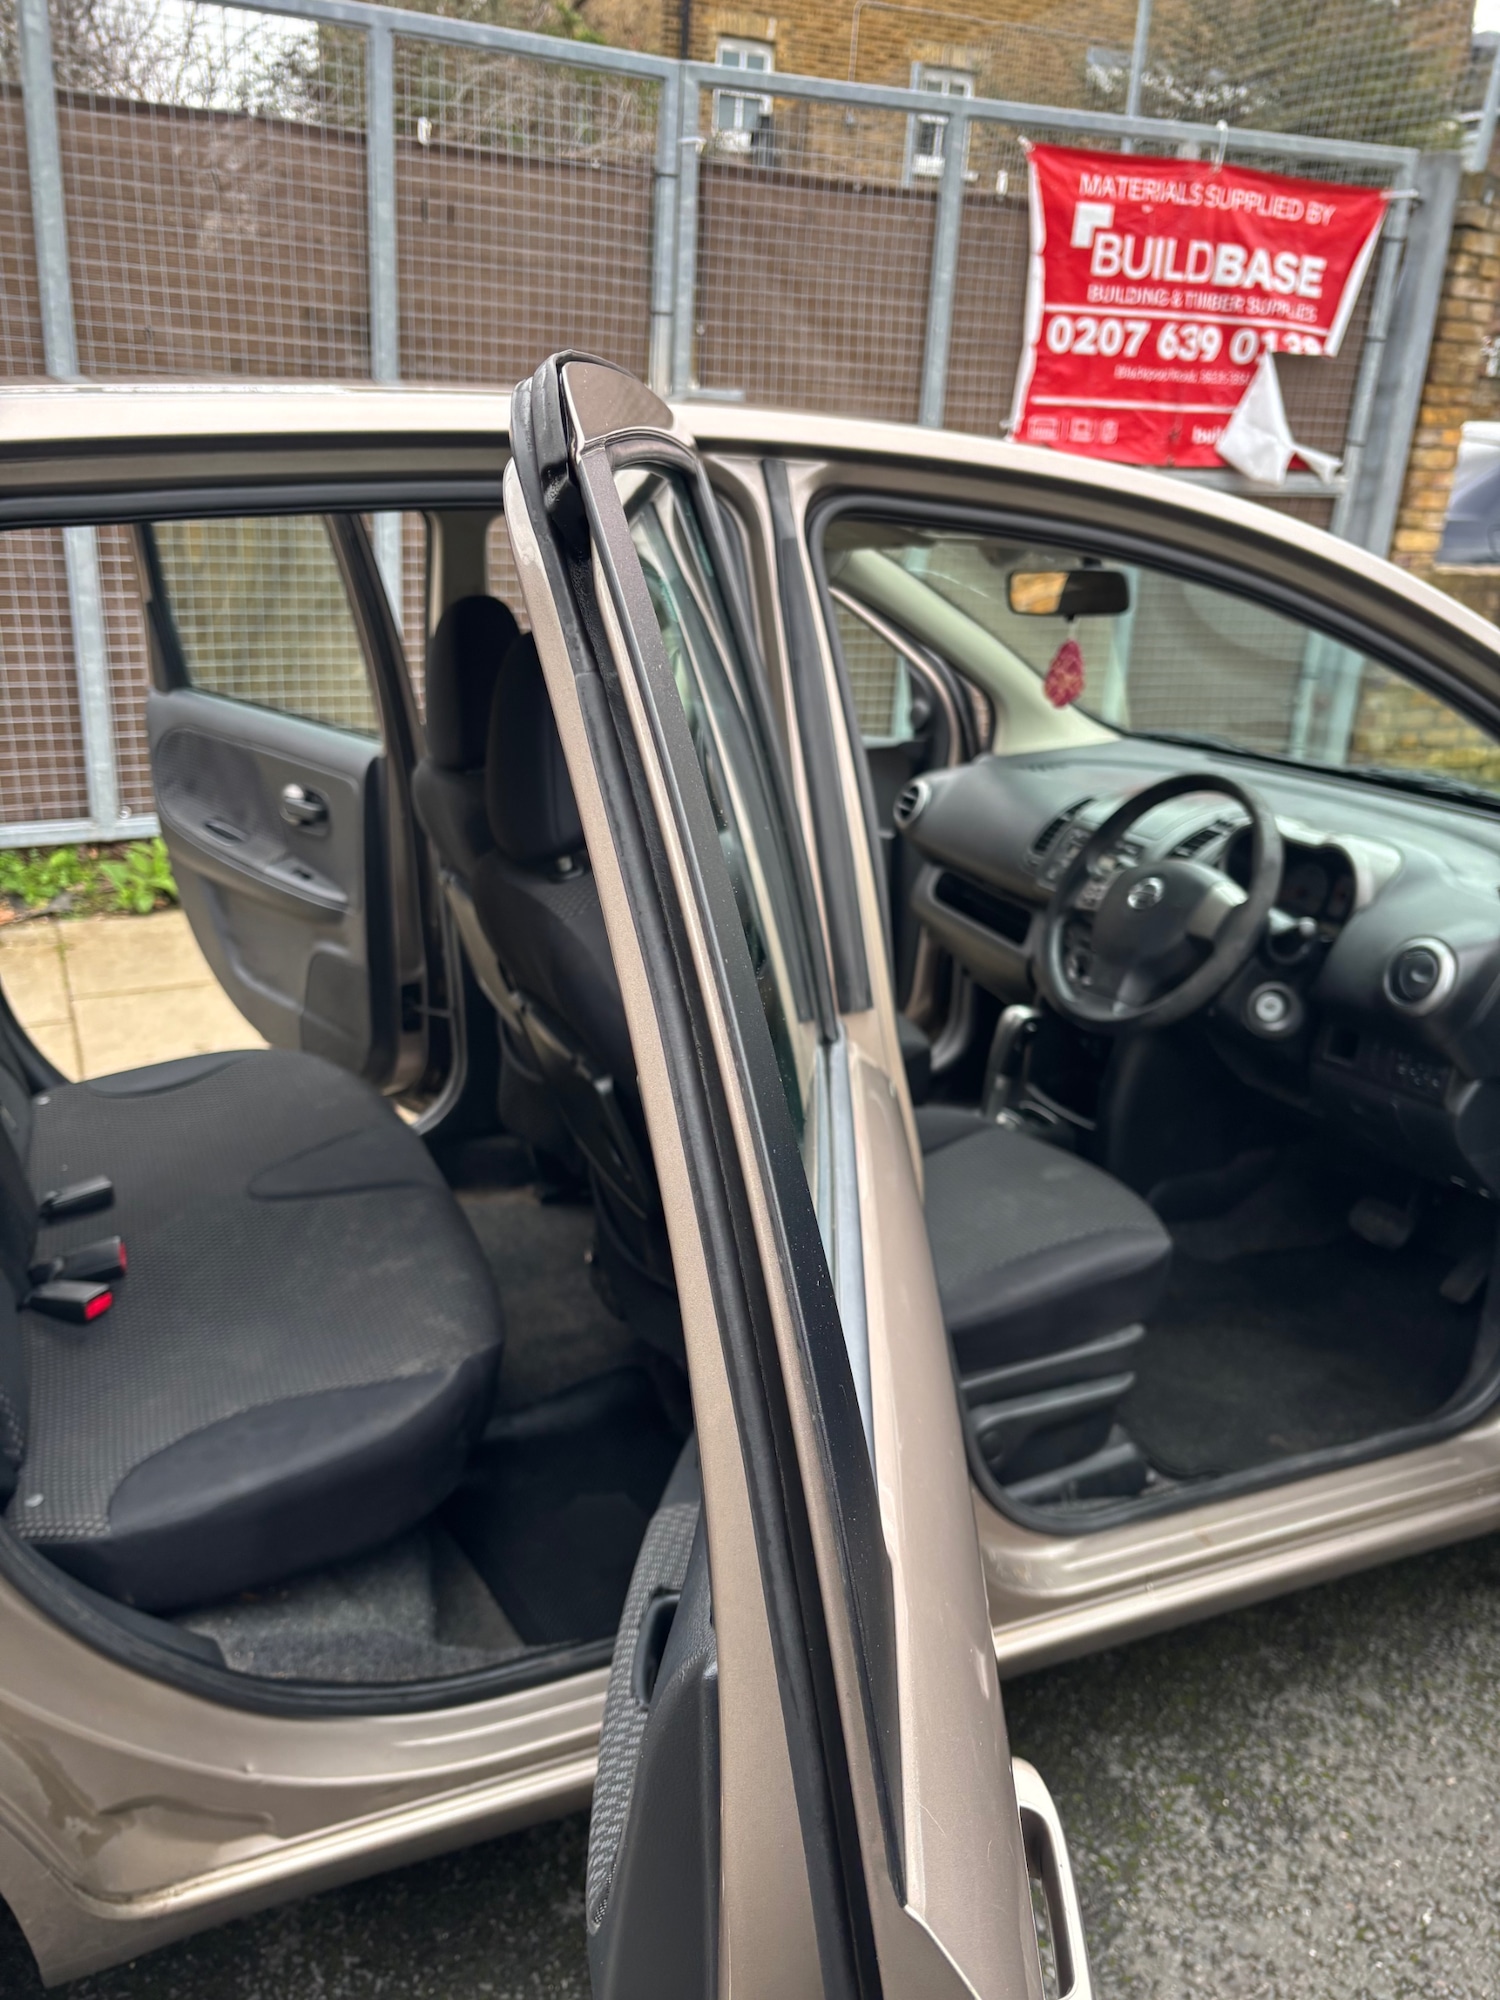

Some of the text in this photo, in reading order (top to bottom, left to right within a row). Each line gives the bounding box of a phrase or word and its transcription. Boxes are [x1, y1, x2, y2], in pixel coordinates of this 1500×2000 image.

[1079, 173, 1337, 226] MATERIALS SUPPLIED BY
[1090, 232, 1328, 299] BUILDBASE
[1046, 315, 1150, 358] 0207
[1156, 322, 1222, 362] 639
